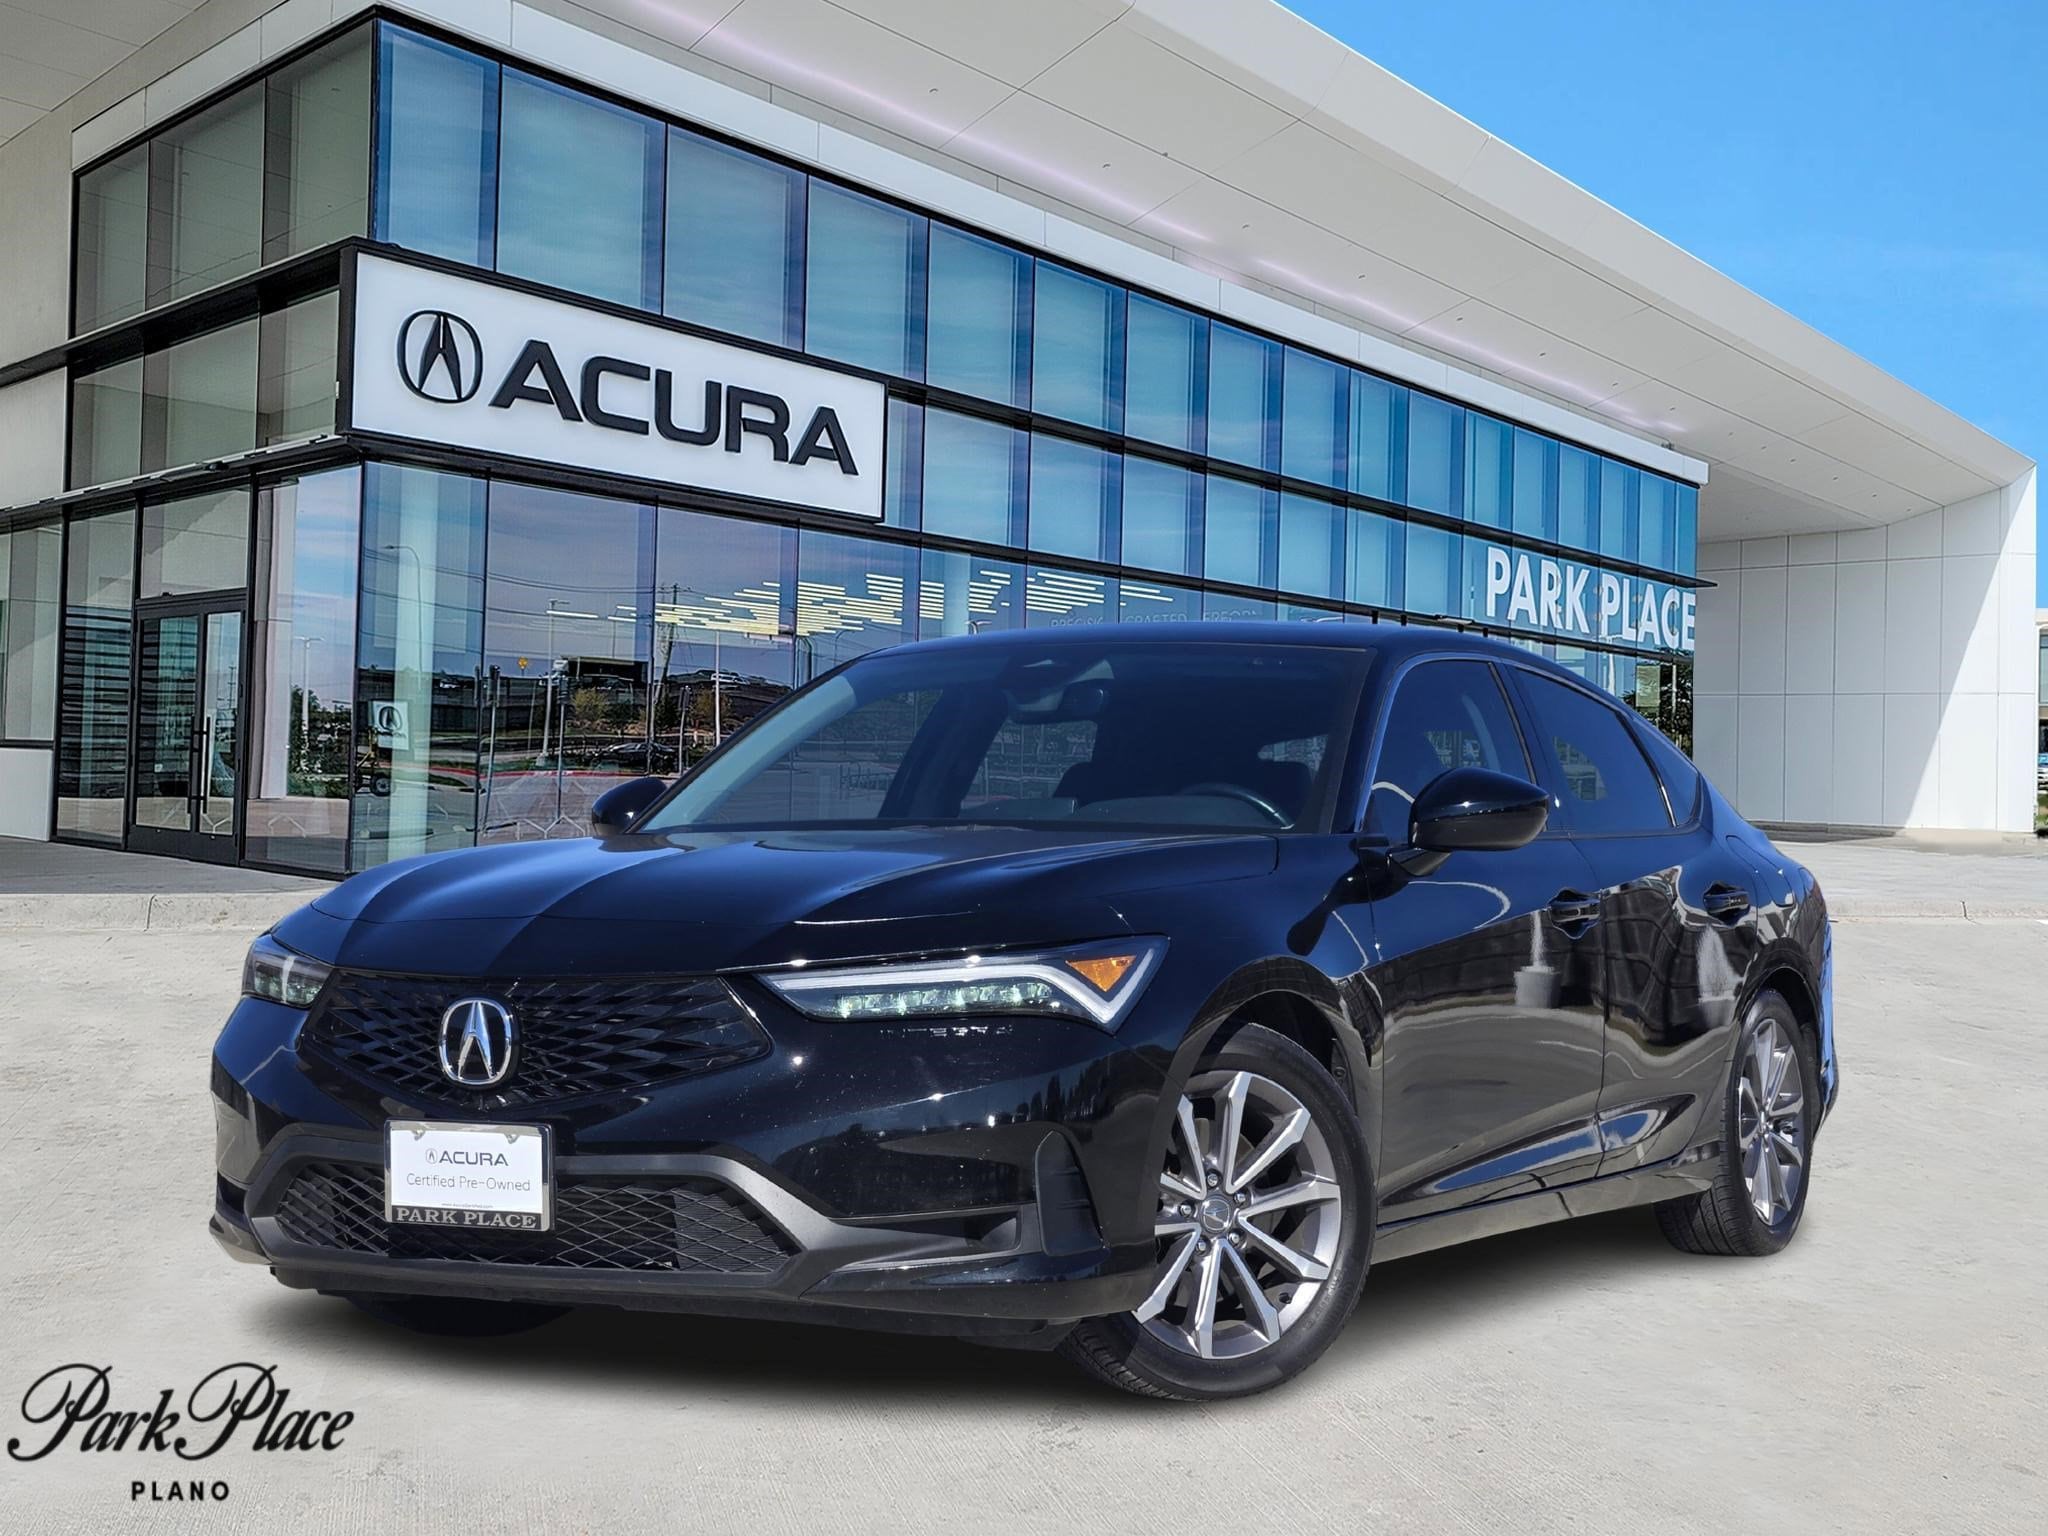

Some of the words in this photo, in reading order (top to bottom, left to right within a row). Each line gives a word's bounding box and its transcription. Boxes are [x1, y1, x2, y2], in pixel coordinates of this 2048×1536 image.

[488, 339, 859, 476] ACURA
[1486, 546, 1590, 634] PARK
[1601, 573, 1697, 651] PLACE
[439, 1150, 509, 1166] ACURA
[406, 1172, 456, 1188] Certified
[459, 1175, 531, 1191] Pre-Owned
[396, 1207, 458, 1225] PARK
[463, 1210, 537, 1229] PLACE
